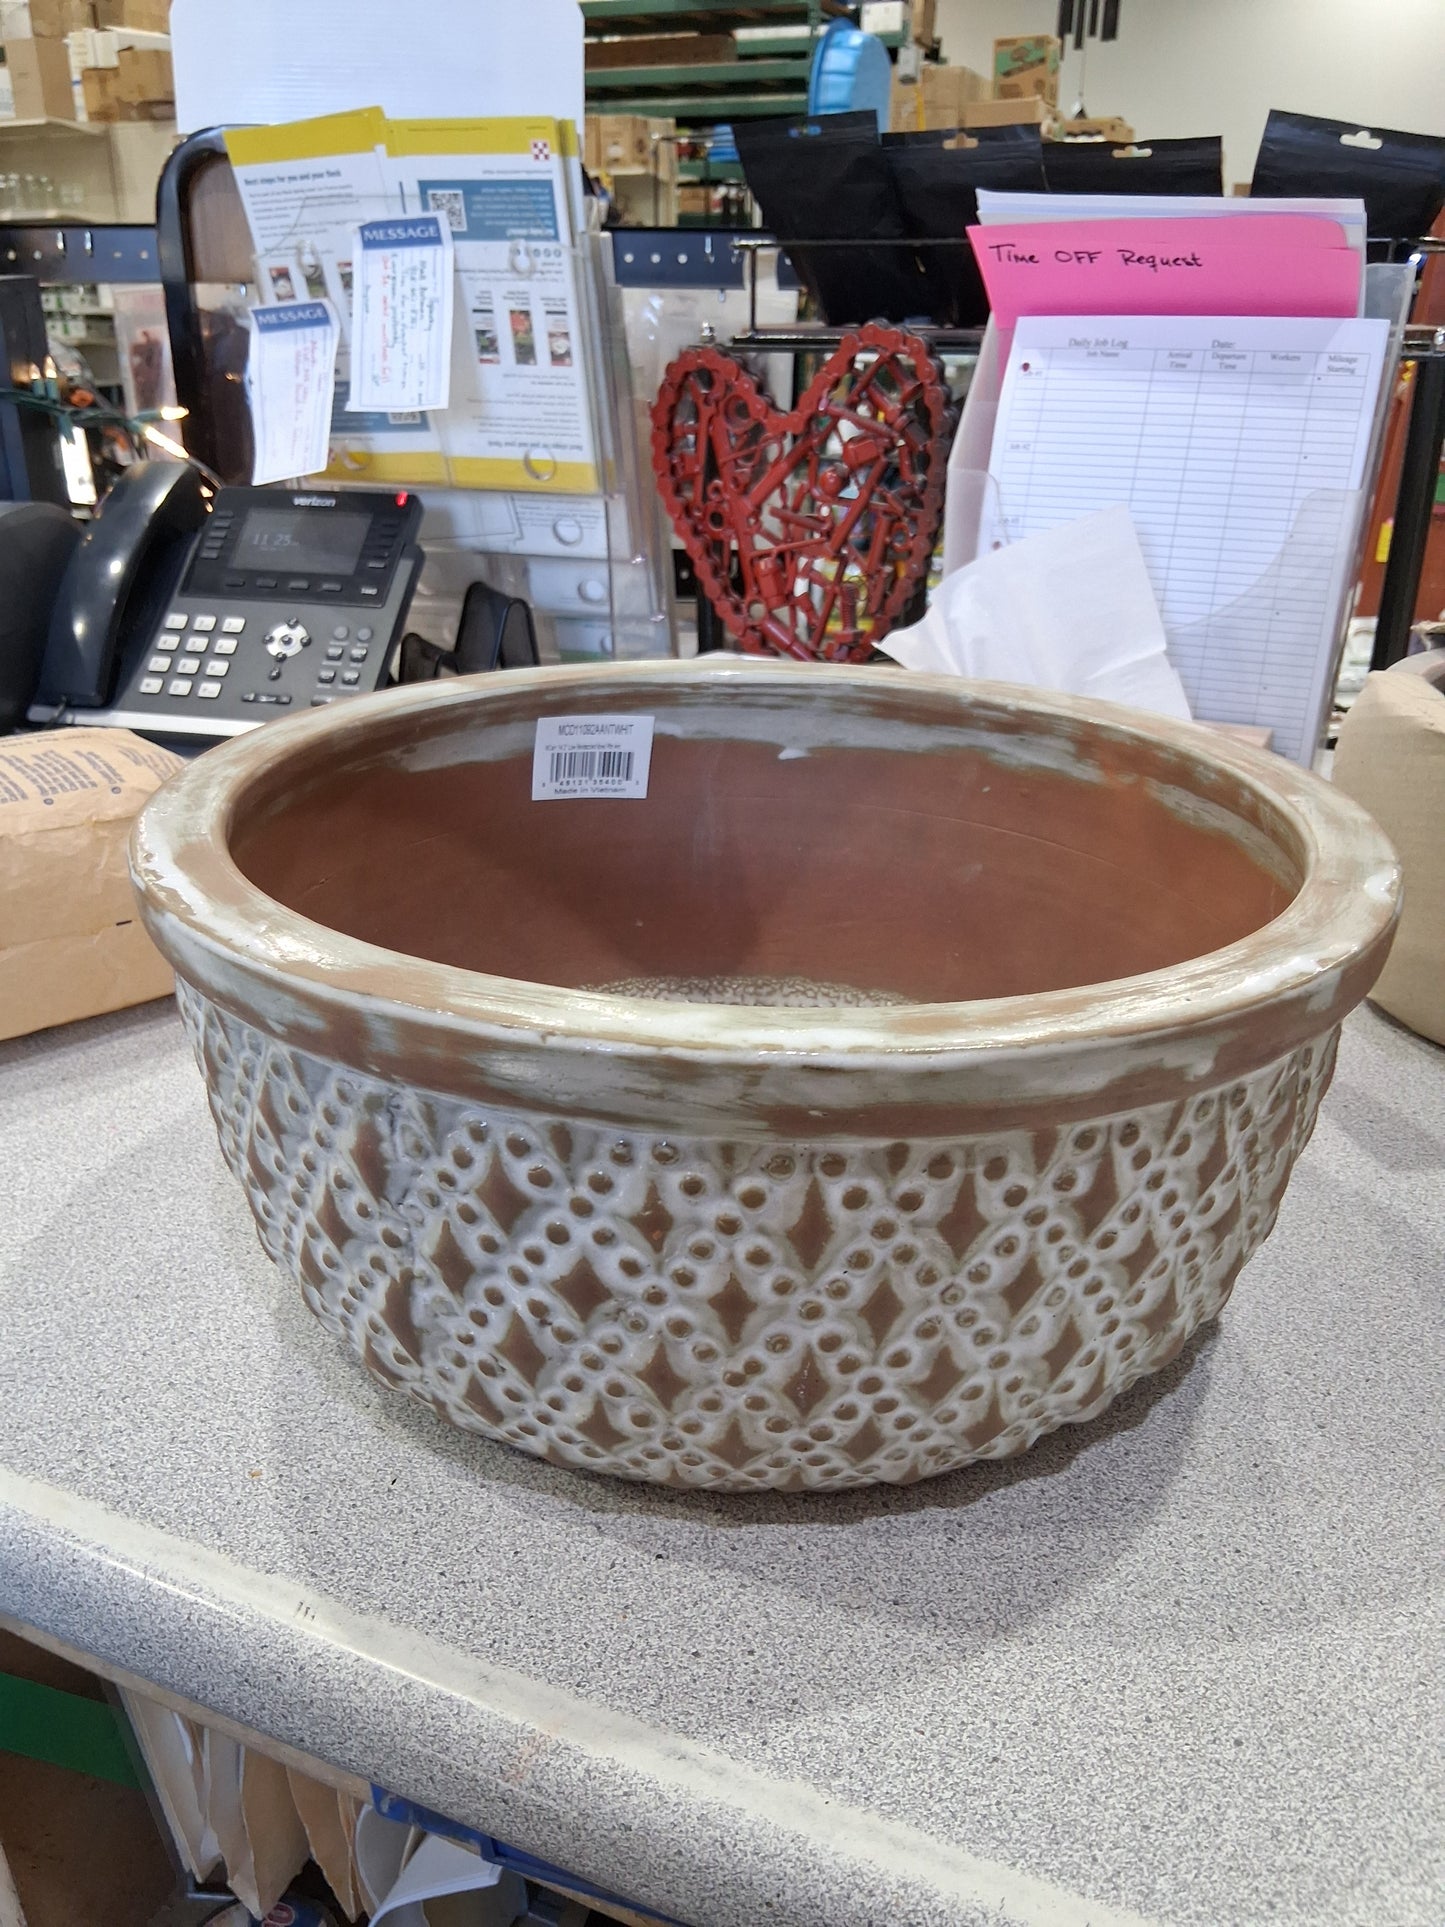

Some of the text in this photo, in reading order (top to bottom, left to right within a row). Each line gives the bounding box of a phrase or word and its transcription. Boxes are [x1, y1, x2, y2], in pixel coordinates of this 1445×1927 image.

[363, 225, 438, 242] MESSAGE
[988, 243, 1203, 272] Time OFF Request
[257, 307, 326, 326] MESSAGE
[1068, 338, 1129, 350] Daily Job Log
[1211, 339, 1235, 349] Date:
[1328, 354, 1358, 365] Mileage
[1218, 362, 1237, 370] Time
[1327, 364, 1356, 374] Starting
[294, 497, 336, 507] verizon
